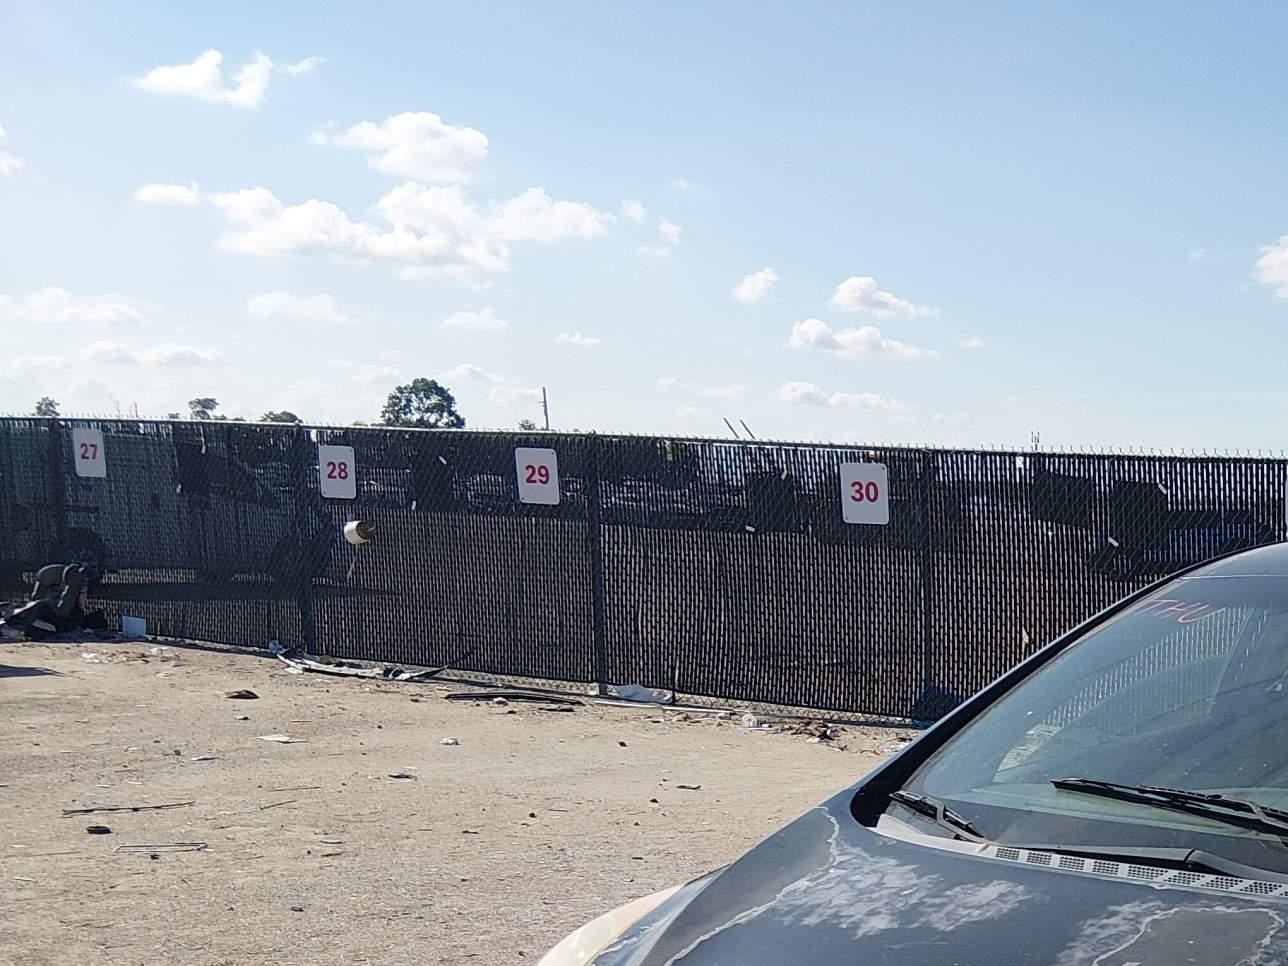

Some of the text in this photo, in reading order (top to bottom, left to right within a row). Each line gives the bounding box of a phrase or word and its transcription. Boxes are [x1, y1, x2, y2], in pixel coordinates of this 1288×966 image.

[80, 442, 98, 460] 27
[326, 460, 349, 481] 28
[525, 464, 550, 485] 29
[850, 480, 879, 503] 30
